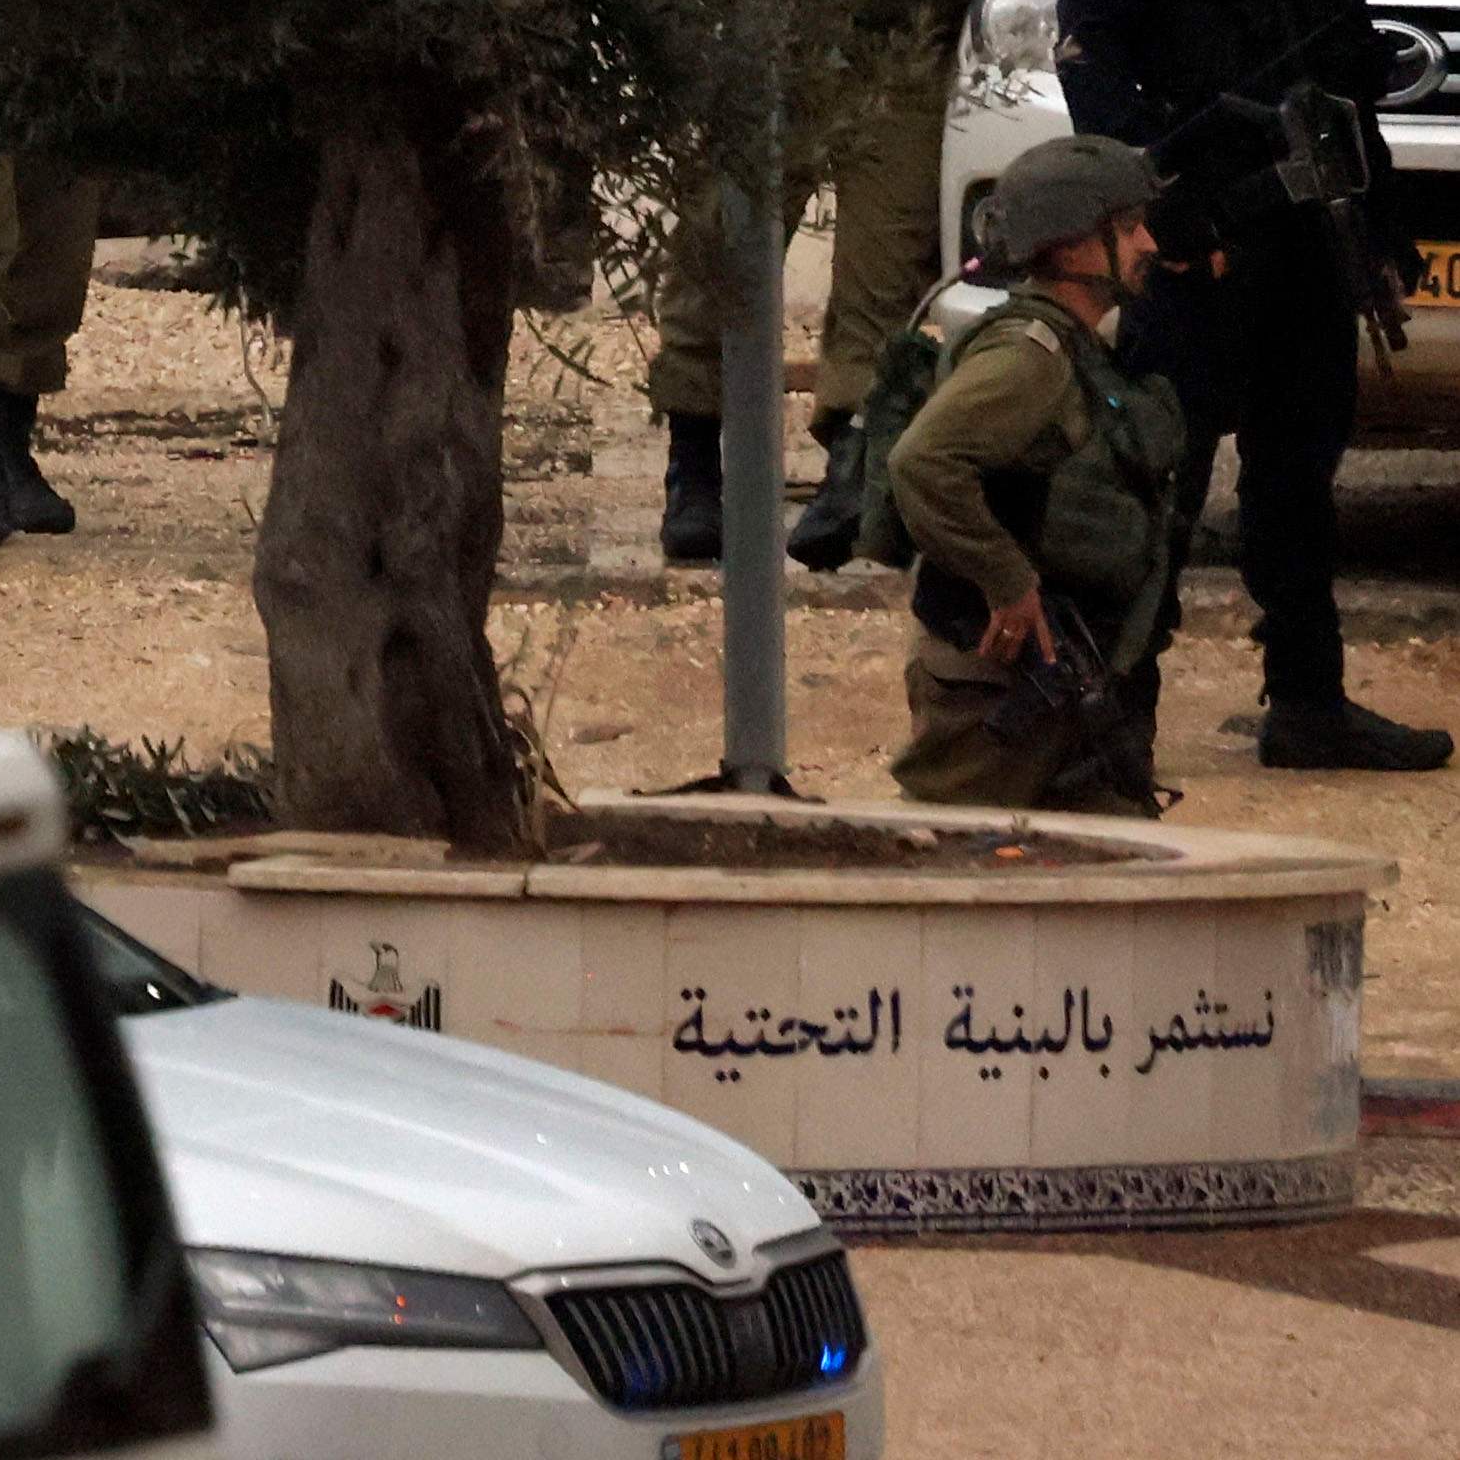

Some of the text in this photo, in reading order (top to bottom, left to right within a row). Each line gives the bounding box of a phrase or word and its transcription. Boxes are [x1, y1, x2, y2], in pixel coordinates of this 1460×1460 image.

[672, 985, 1276, 1083] نستثمر بالبنية التحتية
